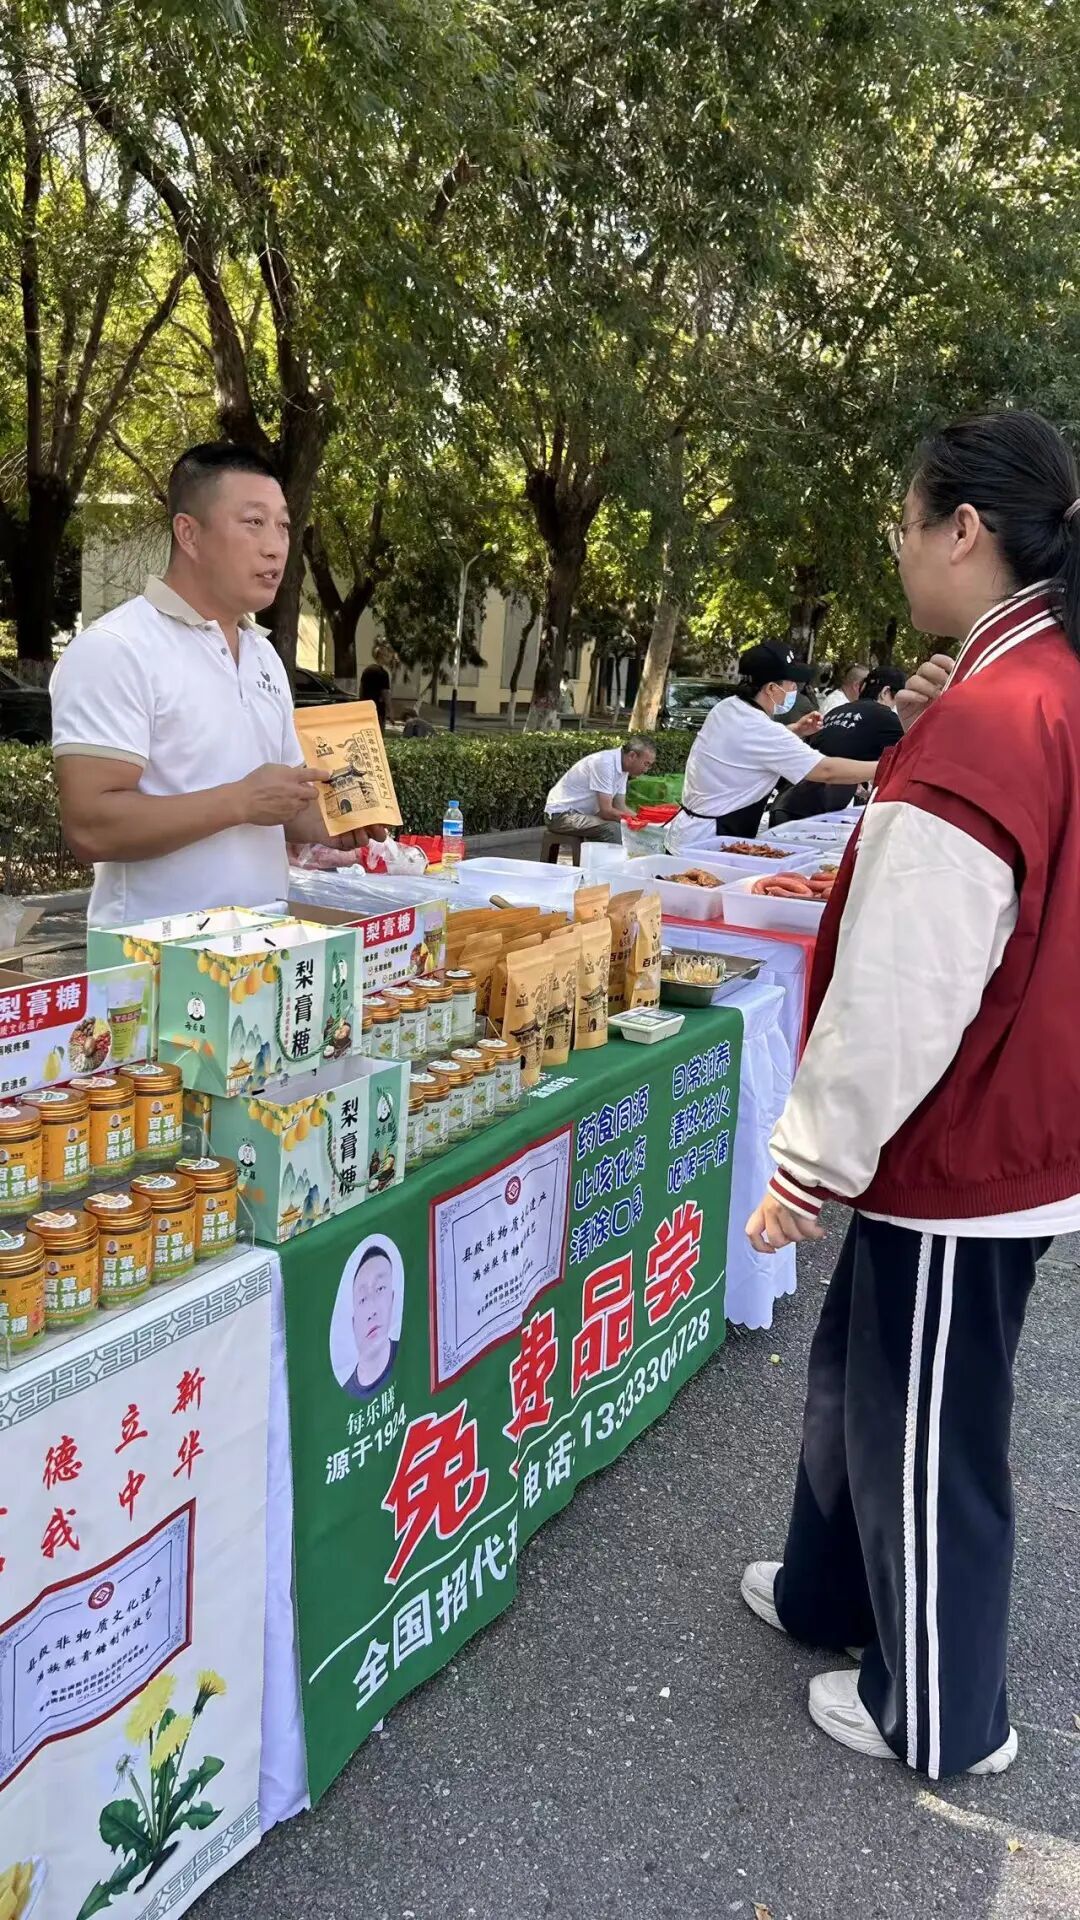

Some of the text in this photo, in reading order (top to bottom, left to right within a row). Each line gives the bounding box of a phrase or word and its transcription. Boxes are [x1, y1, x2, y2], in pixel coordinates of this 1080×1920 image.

[366, 912, 411, 942] 梨膏糖
[0, 982, 82, 1024] 梨膏糖
[292, 958, 314, 1059] 梨膏糖
[338, 1096, 359, 1197] 梨膏糖
[576, 1084, 650, 1161] 药食同源
[573, 1135, 647, 1211] 止咳化痰
[568, 1183, 645, 1265] 清除口臭
[325, 1402, 407, 1485] 源于1924
[346, 1385, 397, 1437] 每乐膳
[523, 1430, 576, 1510] 电话
[581, 1308, 710, 1448] 13333304728
[0, 1430, 204, 1572] 我中华
[26, 1576, 163, 1674] 县级非物质文化遗产
